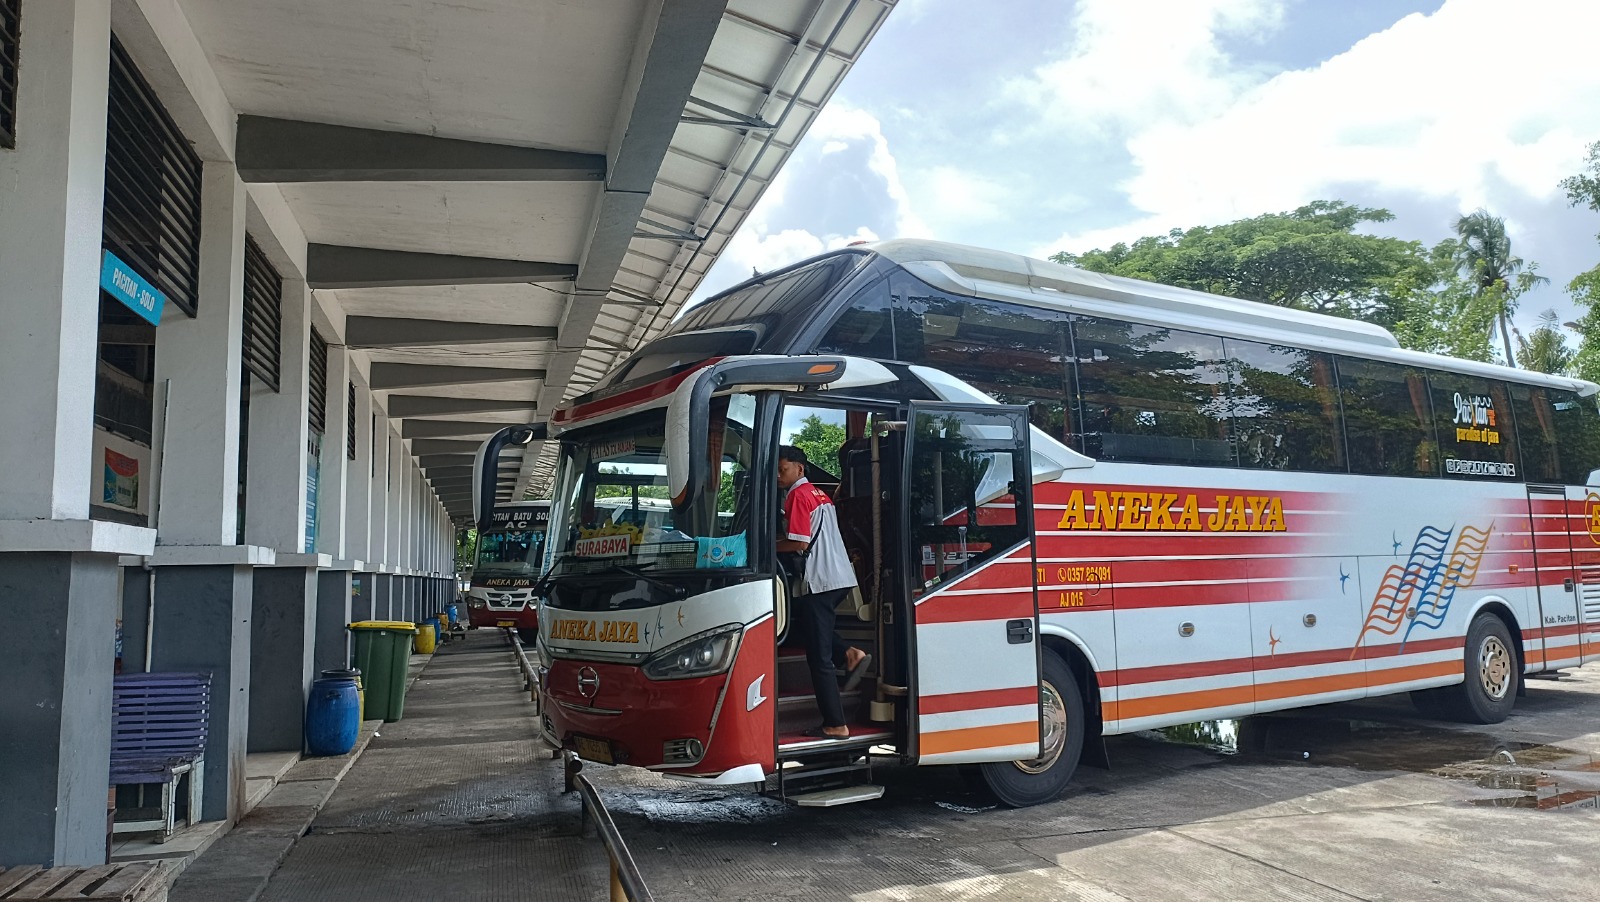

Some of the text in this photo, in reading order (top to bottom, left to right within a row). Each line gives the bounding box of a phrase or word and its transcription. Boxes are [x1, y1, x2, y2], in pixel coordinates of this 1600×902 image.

[112, 267, 138, 299] PACITAN
[140, 289, 155, 312] SOLO
[513, 512, 532, 521] BATU
[1057, 489, 1287, 533] ANEKA JAYA
[575, 537, 628, 557] SURABAYA
[513, 579, 530, 587] JAYA
[1036, 567, 1046, 583] TI
[1067, 567, 1085, 582] 0357
[1060, 591, 1084, 608] AJ 015
[1544, 613, 1577, 625] Kab. Pacitan
[550, 619, 640, 644] ANEKA JAYA
